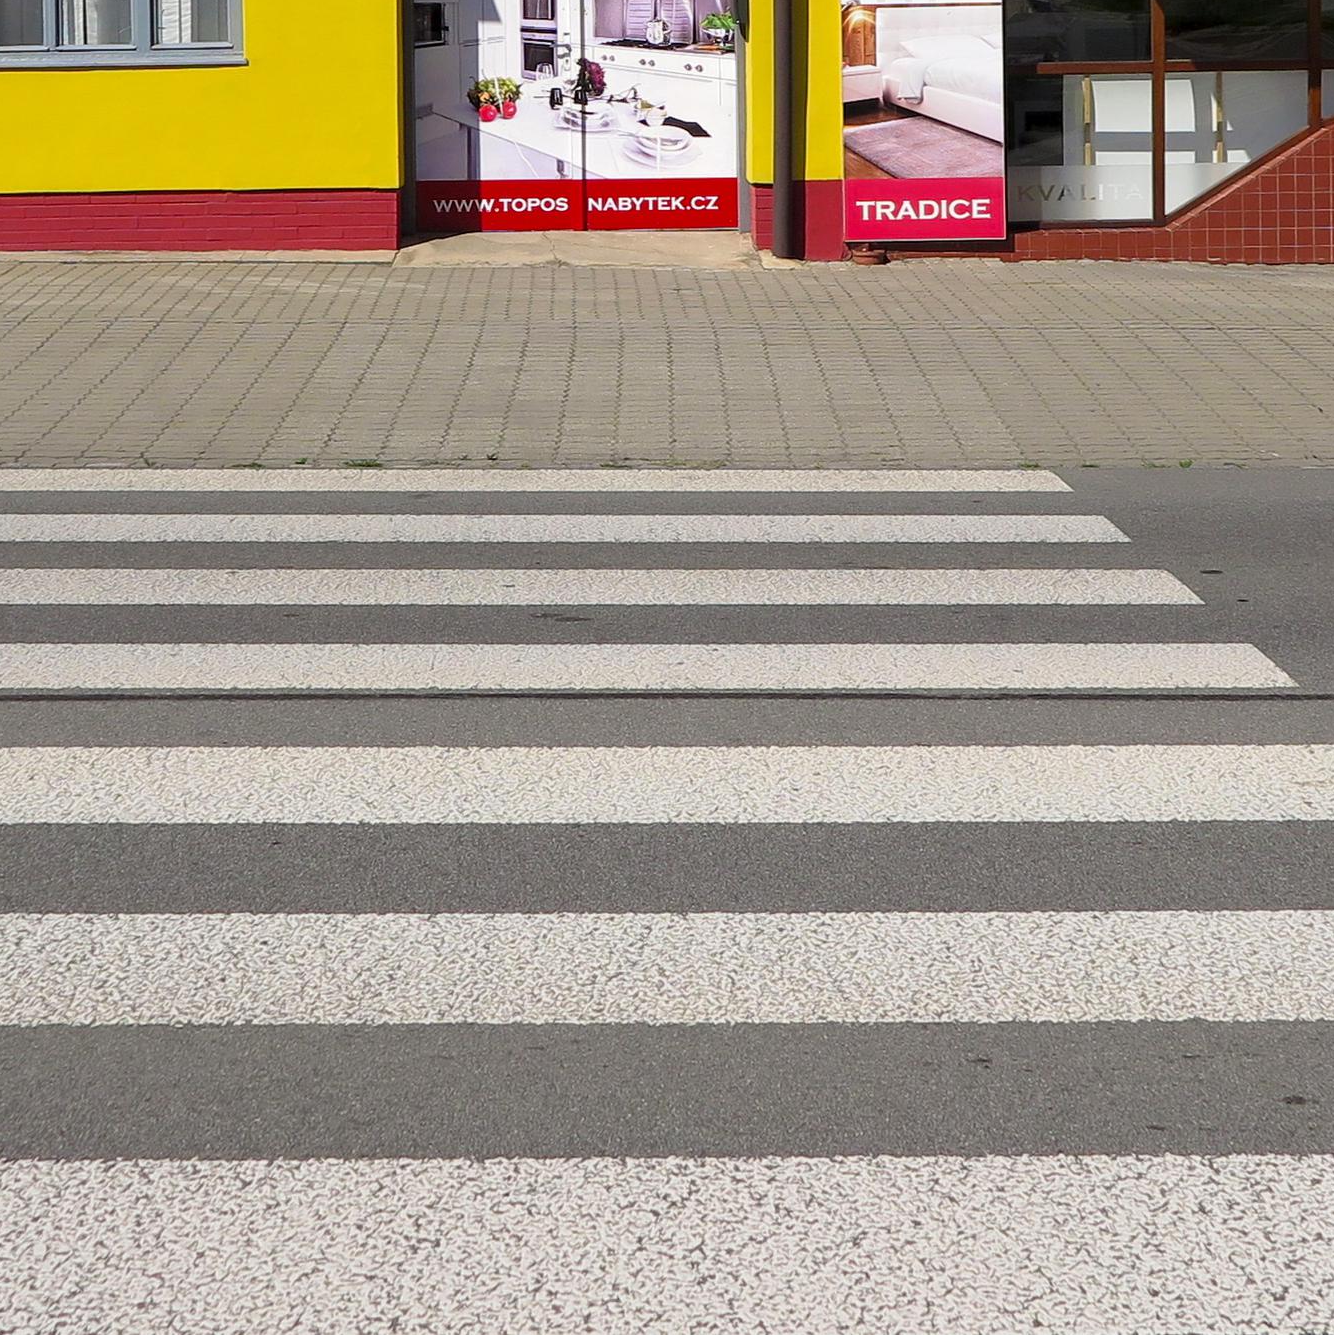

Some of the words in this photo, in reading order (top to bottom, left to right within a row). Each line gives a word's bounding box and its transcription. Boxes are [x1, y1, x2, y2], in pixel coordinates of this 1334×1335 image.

[1017, 183, 1145, 201] KVALITA
[433, 196, 569, 213] WWW.TOPOS
[587, 195, 719, 212] NABYTEK.CZ
[855, 198, 991, 221] TRADICE
